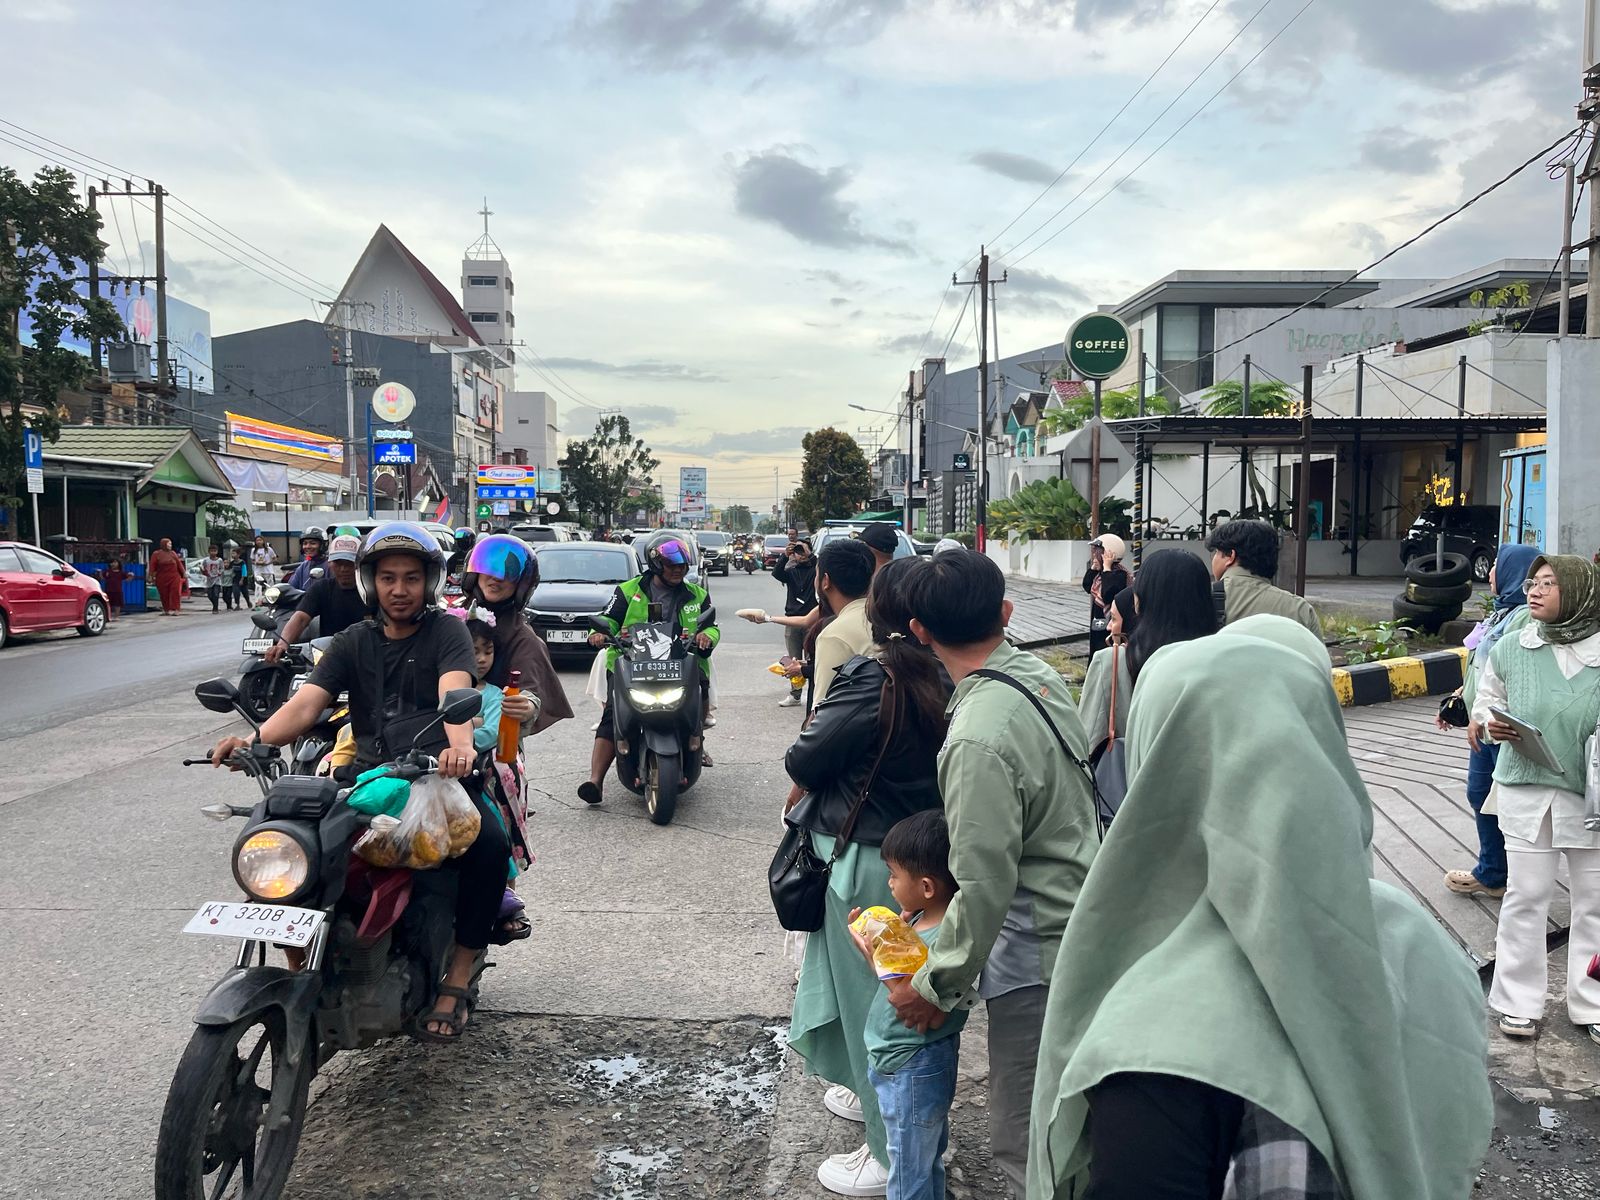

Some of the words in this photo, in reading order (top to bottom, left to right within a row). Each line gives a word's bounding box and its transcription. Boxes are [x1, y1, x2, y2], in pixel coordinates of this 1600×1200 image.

[1075, 338, 1126, 349] GOFFEÉ
[28, 433, 39, 463] P
[547, 631, 556, 639] KT
[633, 663, 643, 671] KT
[201, 904, 229, 918] KT
[234, 906, 285, 922] 3208
[291, 912, 317, 928] JA
